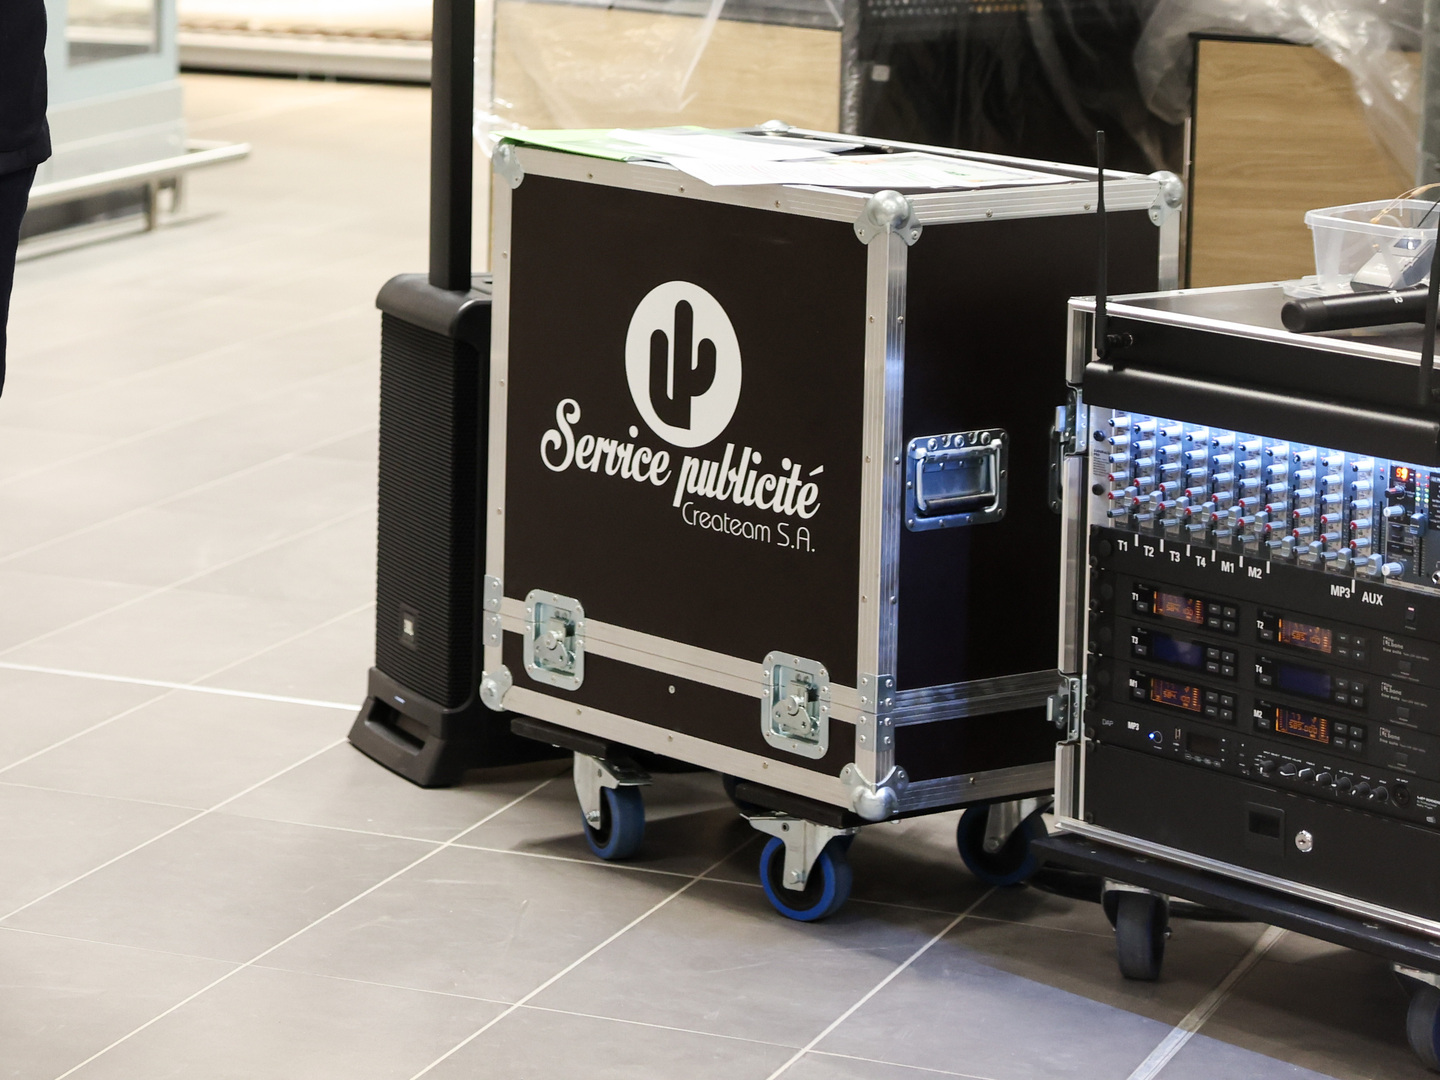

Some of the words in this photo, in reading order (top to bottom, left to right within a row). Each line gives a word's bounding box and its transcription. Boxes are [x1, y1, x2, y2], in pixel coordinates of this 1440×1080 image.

[540, 398, 672, 486] Service
[672, 443, 825, 520] publicité
[681, 502, 772, 543] Createam
[776, 522, 816, 552] S.A.
[1117, 539, 1128, 552] T1
[1143, 545, 1155, 557] T2
[1169, 550, 1181, 562] T3
[1195, 555, 1207, 568] T4
[1221, 560, 1235, 573] M1
[1248, 566, 1262, 579] M2
[1330, 584, 1351, 599] MP3
[1361, 591, 1384, 607] AUX
[1131, 592, 1139, 601] T1
[1256, 620, 1264, 630] T2
[1131, 635, 1139, 645] T3
[1255, 664, 1263, 674] T4
[1129, 678, 1138, 688] M1
[1253, 709, 1263, 719] M2
[1127, 721, 1140, 731] MP3
